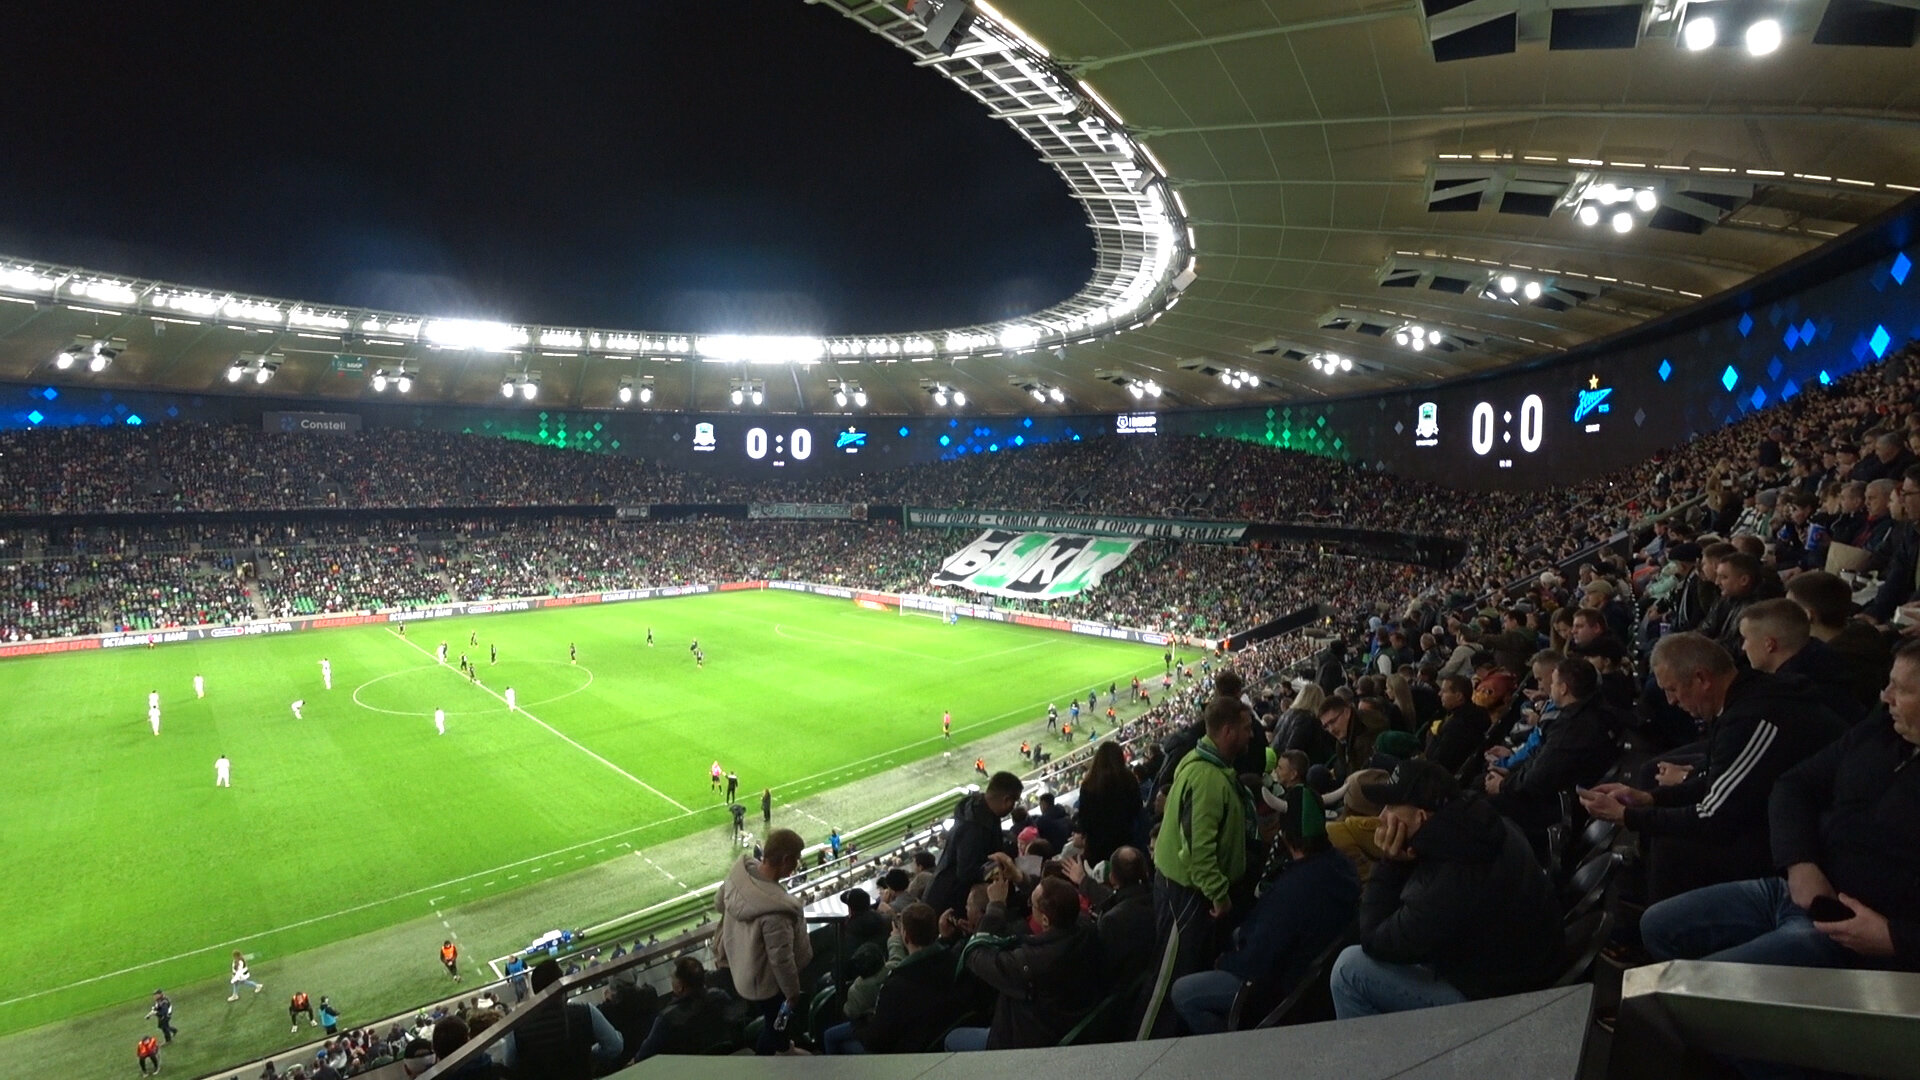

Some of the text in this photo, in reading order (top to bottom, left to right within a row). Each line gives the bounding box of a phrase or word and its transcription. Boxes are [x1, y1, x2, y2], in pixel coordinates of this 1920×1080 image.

[300, 419, 346, 430] Constell
[945, 514, 980, 526] ГОРОД
[995, 514, 1039, 527] САМЫЙ
[1102, 520, 1147, 535] ГОРОД
[1152, 524, 1174, 537] НА
